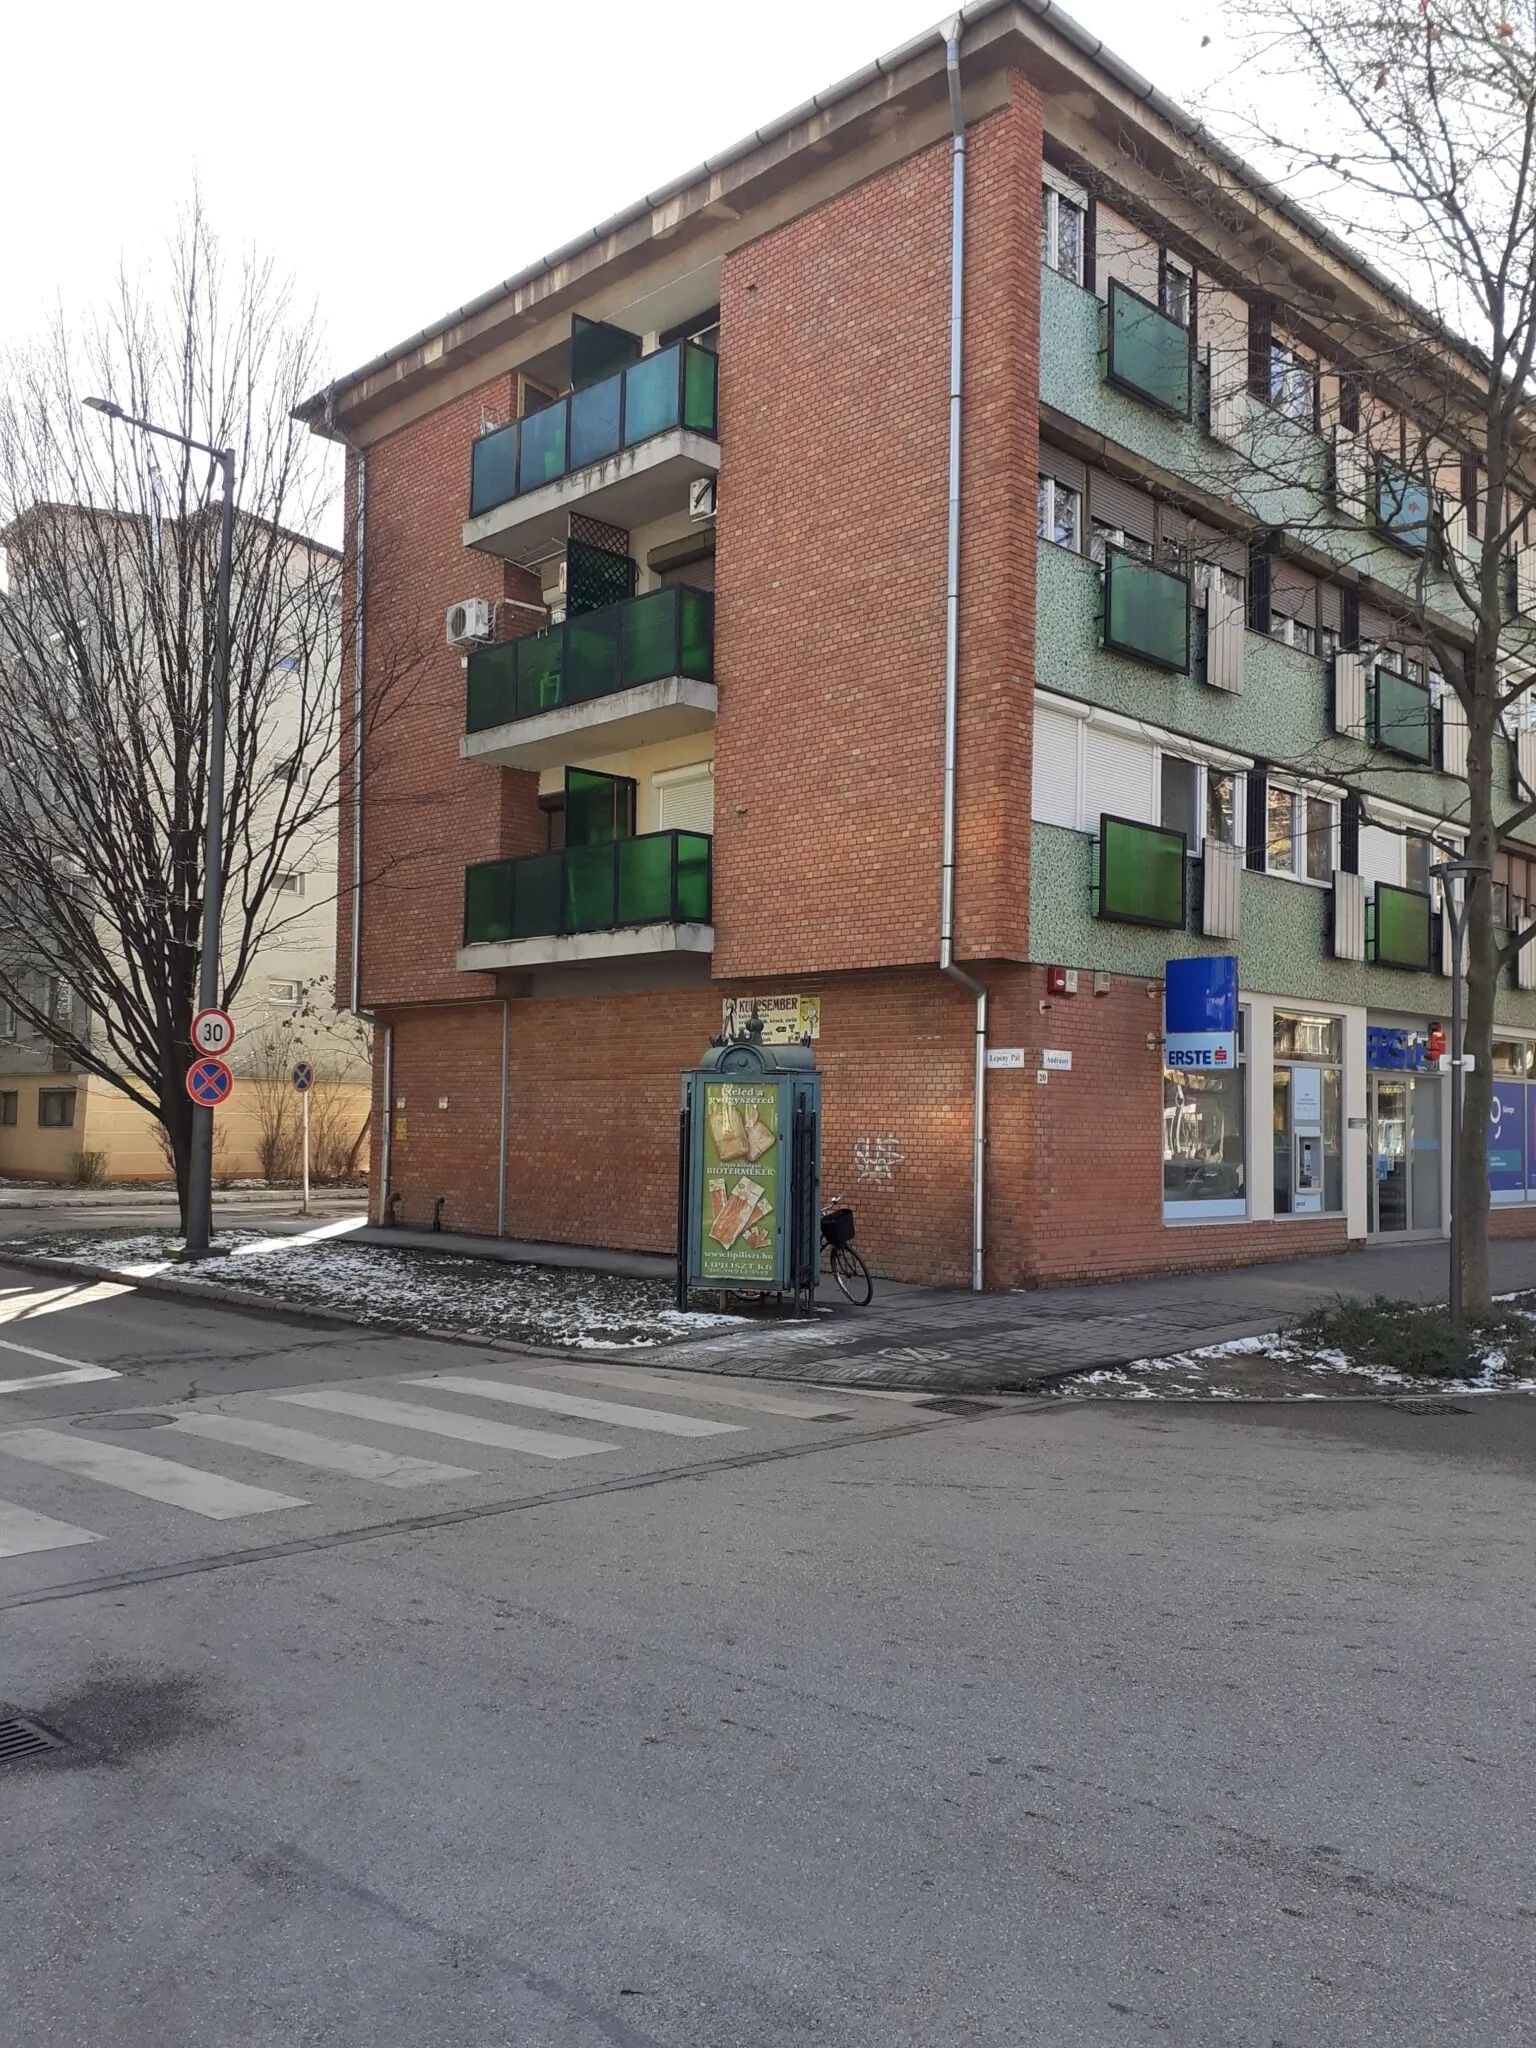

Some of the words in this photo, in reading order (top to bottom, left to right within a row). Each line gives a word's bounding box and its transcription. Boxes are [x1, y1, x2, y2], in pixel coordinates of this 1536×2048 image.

[204, 1023, 223, 1042] 30
[1168, 1050, 1212, 1065] ERSTE
[1039, 1073, 1047, 1082] 20
[704, 1251, 773, 1260] www.lipiliszt.hu
